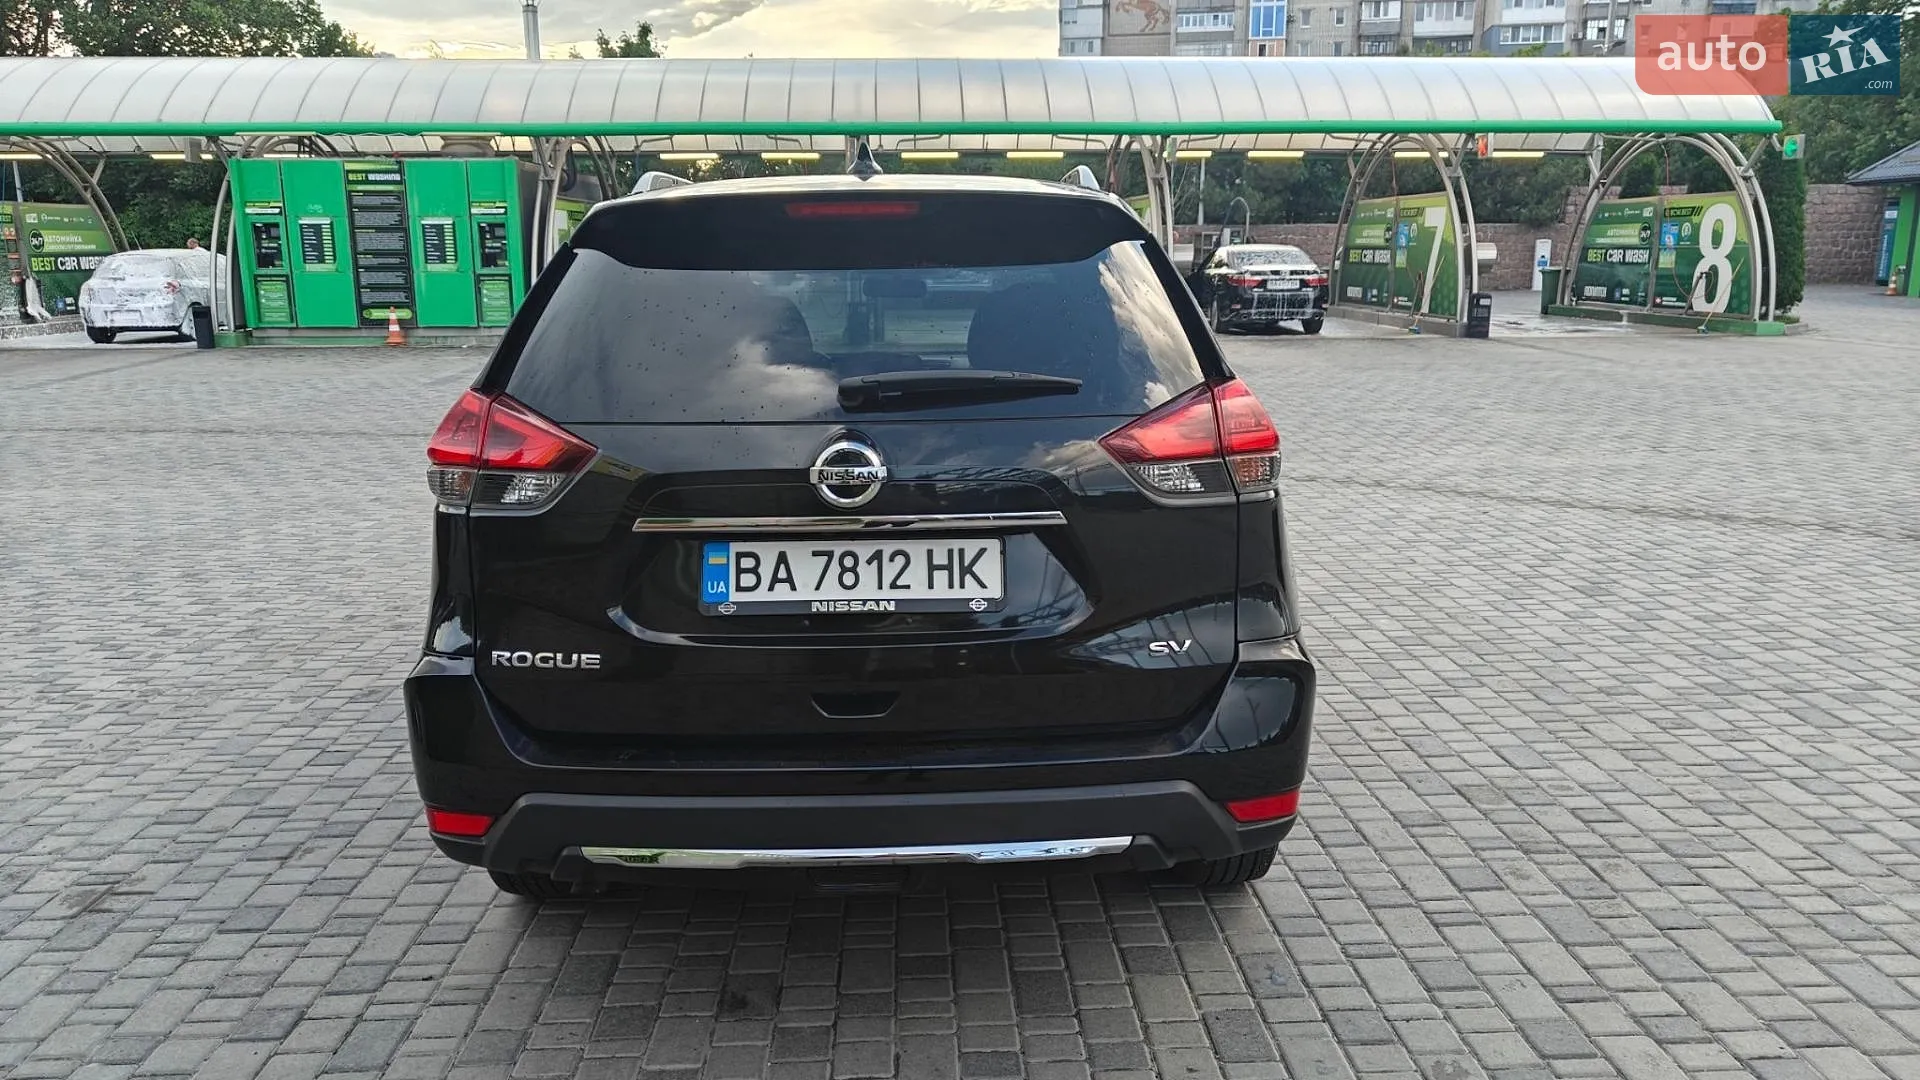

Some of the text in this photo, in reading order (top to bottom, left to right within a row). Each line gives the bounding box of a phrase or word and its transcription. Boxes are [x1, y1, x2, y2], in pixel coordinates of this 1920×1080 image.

[31, 257, 55, 271] BEST
[1421, 207, 1446, 313] 7
[1588, 250, 1605, 262] BEST
[1692, 203, 1737, 313] 8
[817, 470, 879, 482] NISSAN
[734, 547, 989, 593] BA 7812 HK
[707, 581, 727, 594] UA
[811, 600, 896, 612] NISSAN
[1148, 639, 1192, 657] SV
[491, 650, 601, 669] ROGUE
